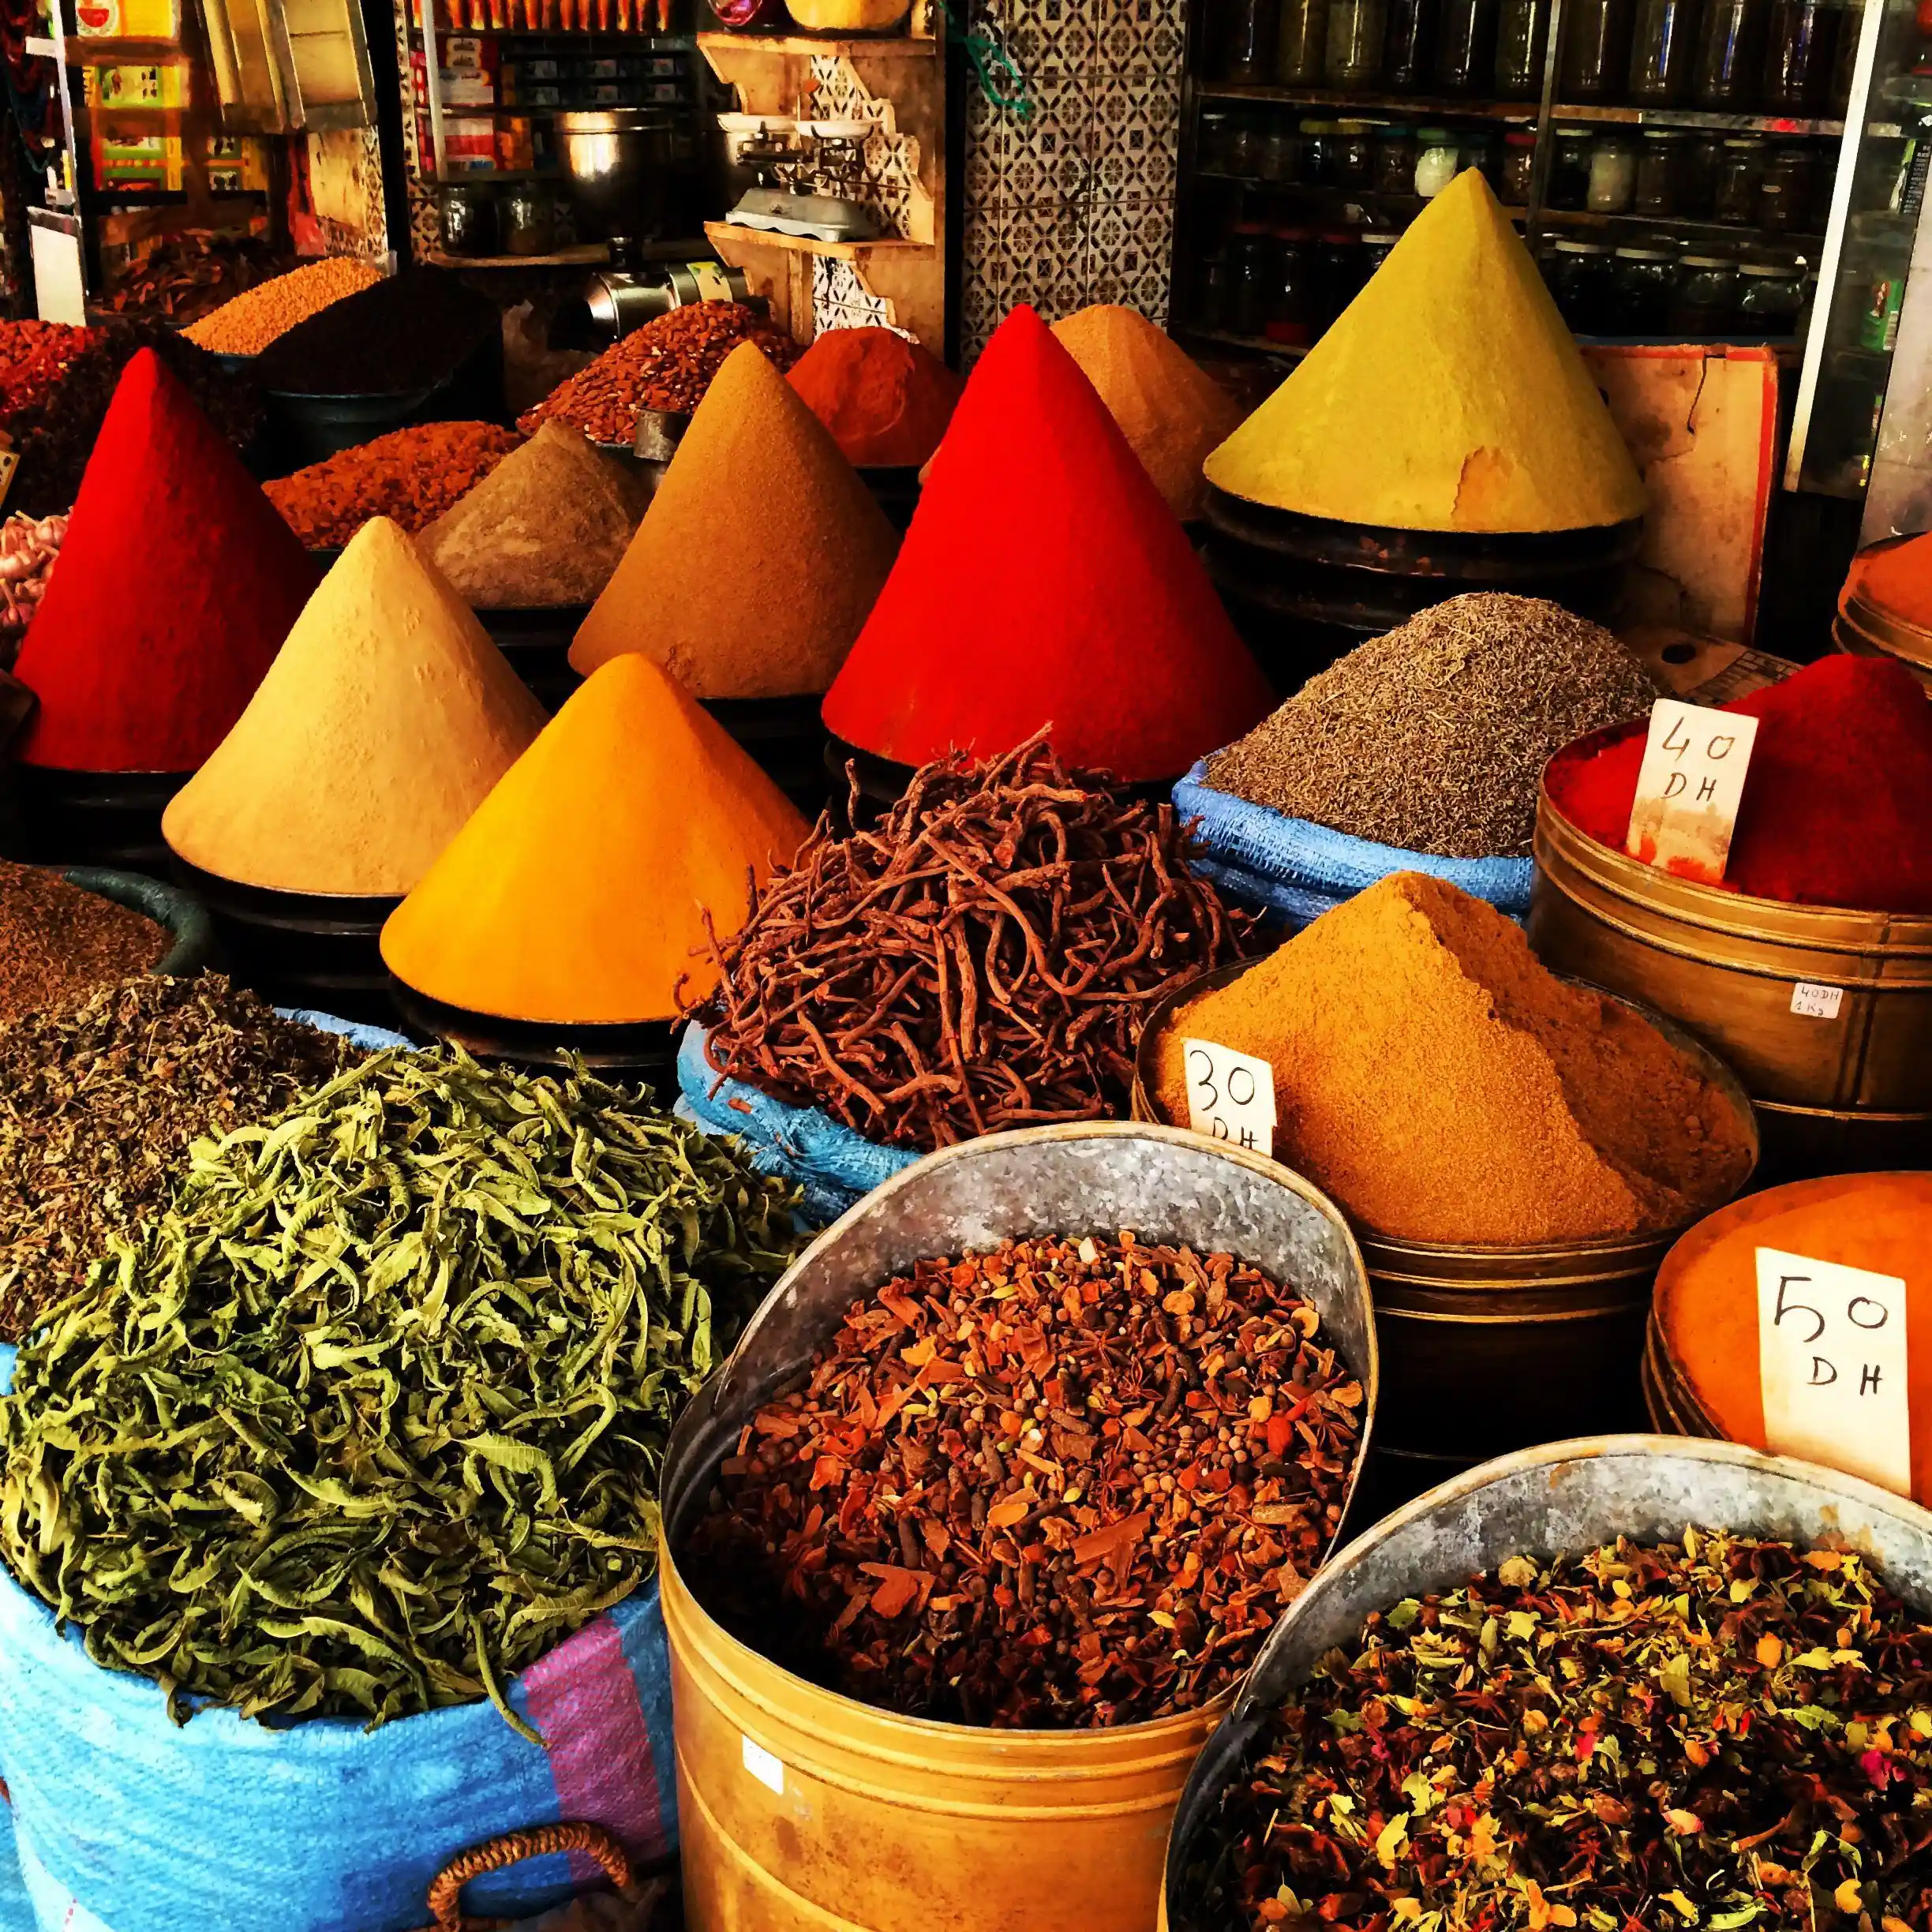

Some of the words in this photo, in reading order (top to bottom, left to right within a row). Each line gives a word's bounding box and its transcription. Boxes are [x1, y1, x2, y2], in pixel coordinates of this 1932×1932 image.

[1661, 716, 1735, 762] 40
[1660, 772, 1717, 802] DH
[1189, 1050, 1255, 1112] 30
[1211, 1116, 1260, 1150] DH
[1773, 1275, 1889, 1343] 50
[1807, 1356, 1883, 1396] DH
